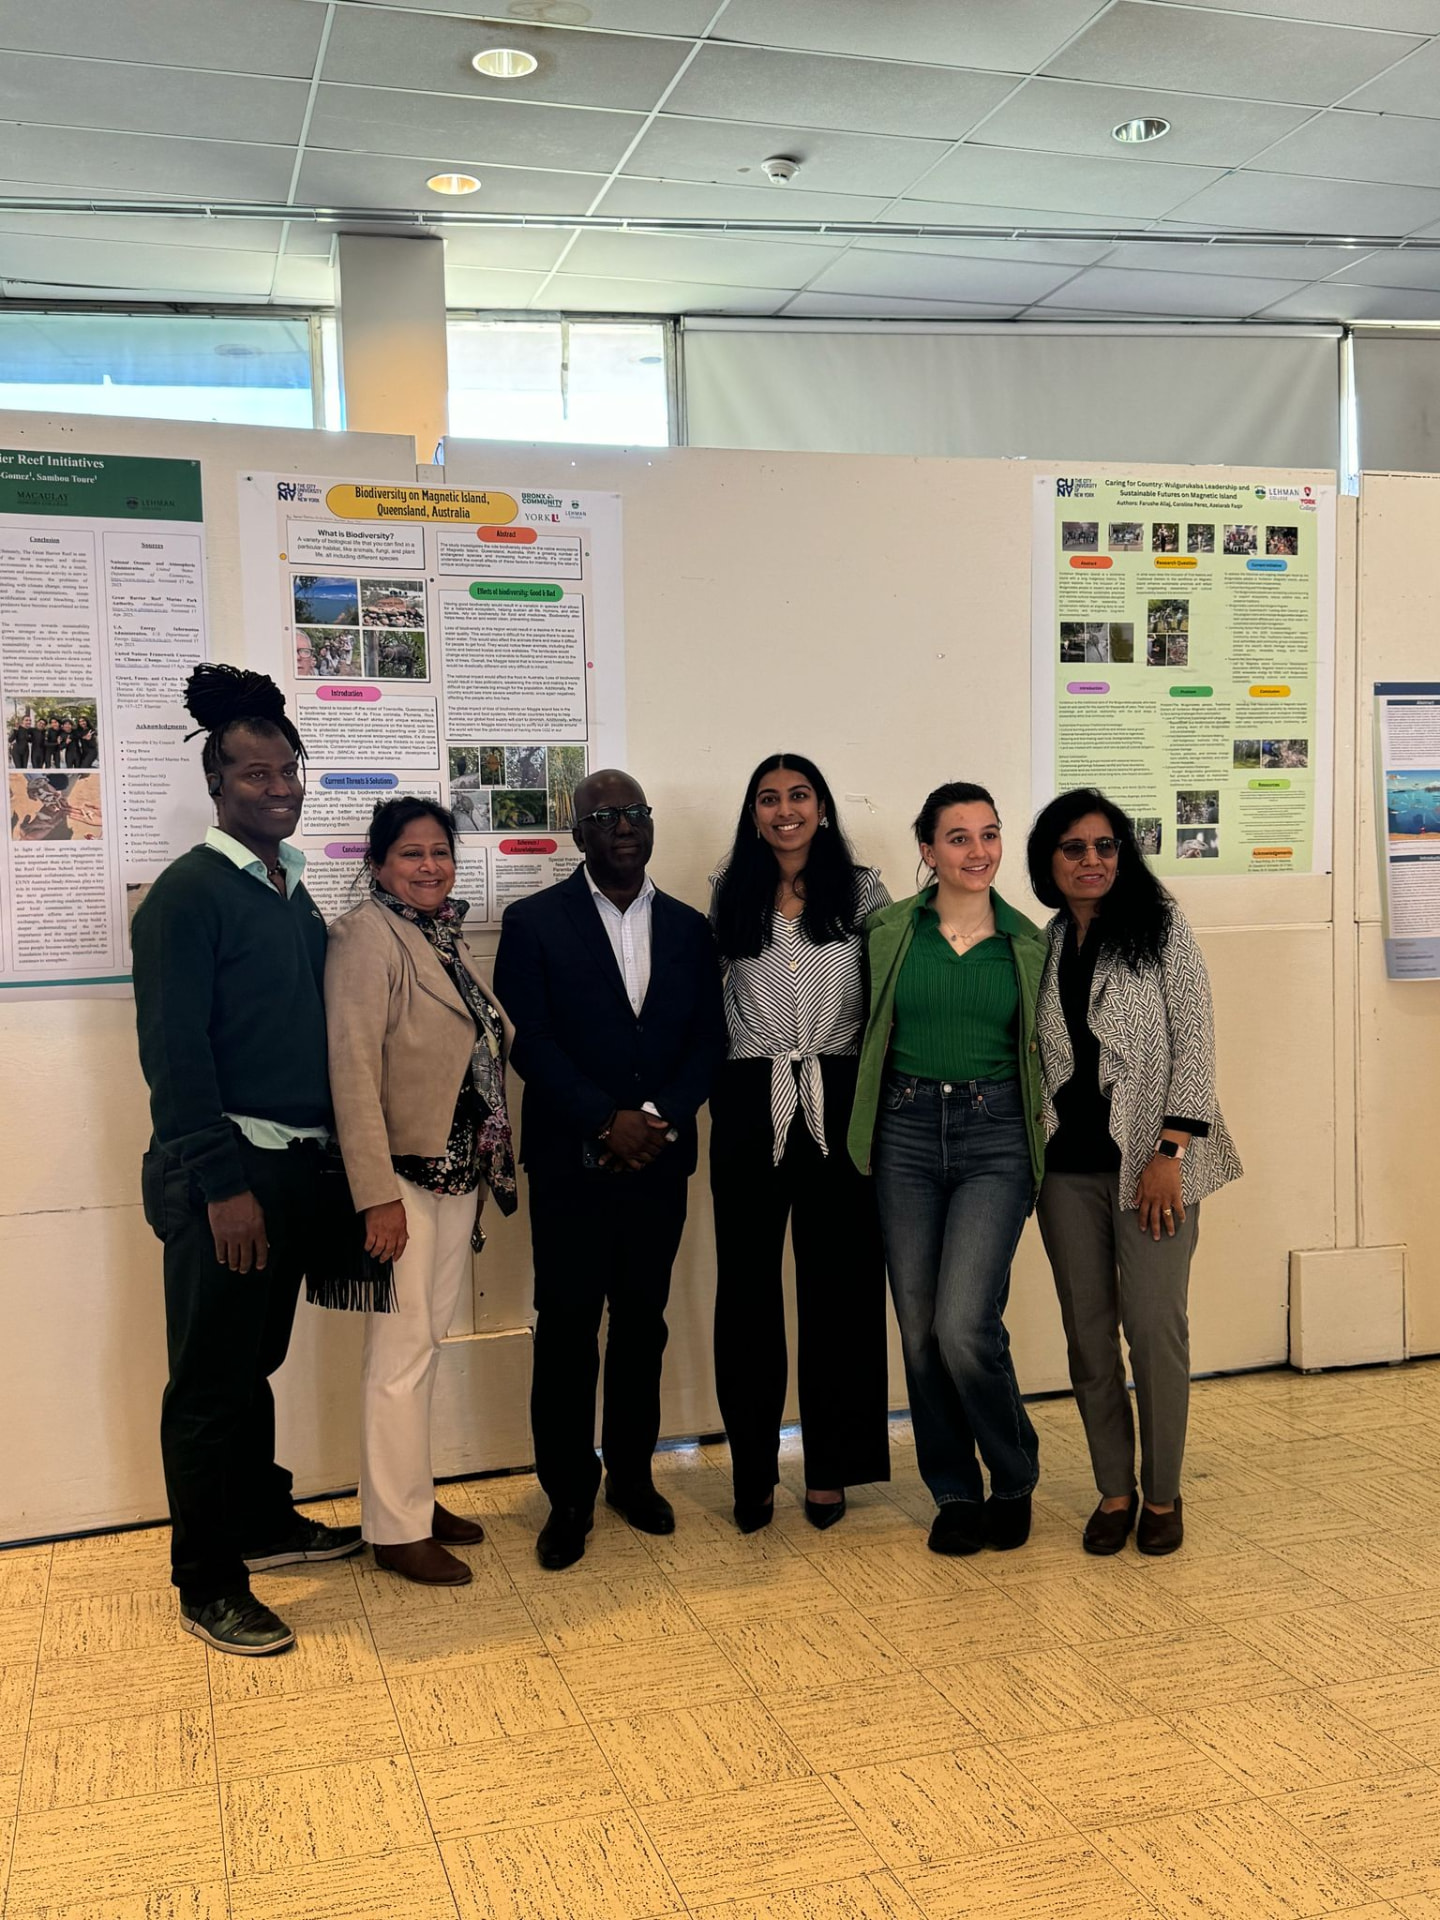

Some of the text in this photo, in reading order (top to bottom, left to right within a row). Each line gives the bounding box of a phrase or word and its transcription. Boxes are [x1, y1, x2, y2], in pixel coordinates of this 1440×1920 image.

[18, 454, 44, 466] Reef
[47, 456, 105, 468] Initiatives
[36, 473, 70, 482] Sambou
[1137, 480, 1164, 489] Country:
[17, 491, 69, 500] MACAULAY
[355, 487, 490, 505] Biodiversity on Magnetic Island,
[1120, 489, 1156, 497] Sustainable
[377, 504, 470, 518] Queensland, Australia
[525, 513, 550, 521] YORK
[318, 529, 337, 537] What
[346, 531, 394, 540] Biodiversity?
[496, 530, 516, 538] Abstract
